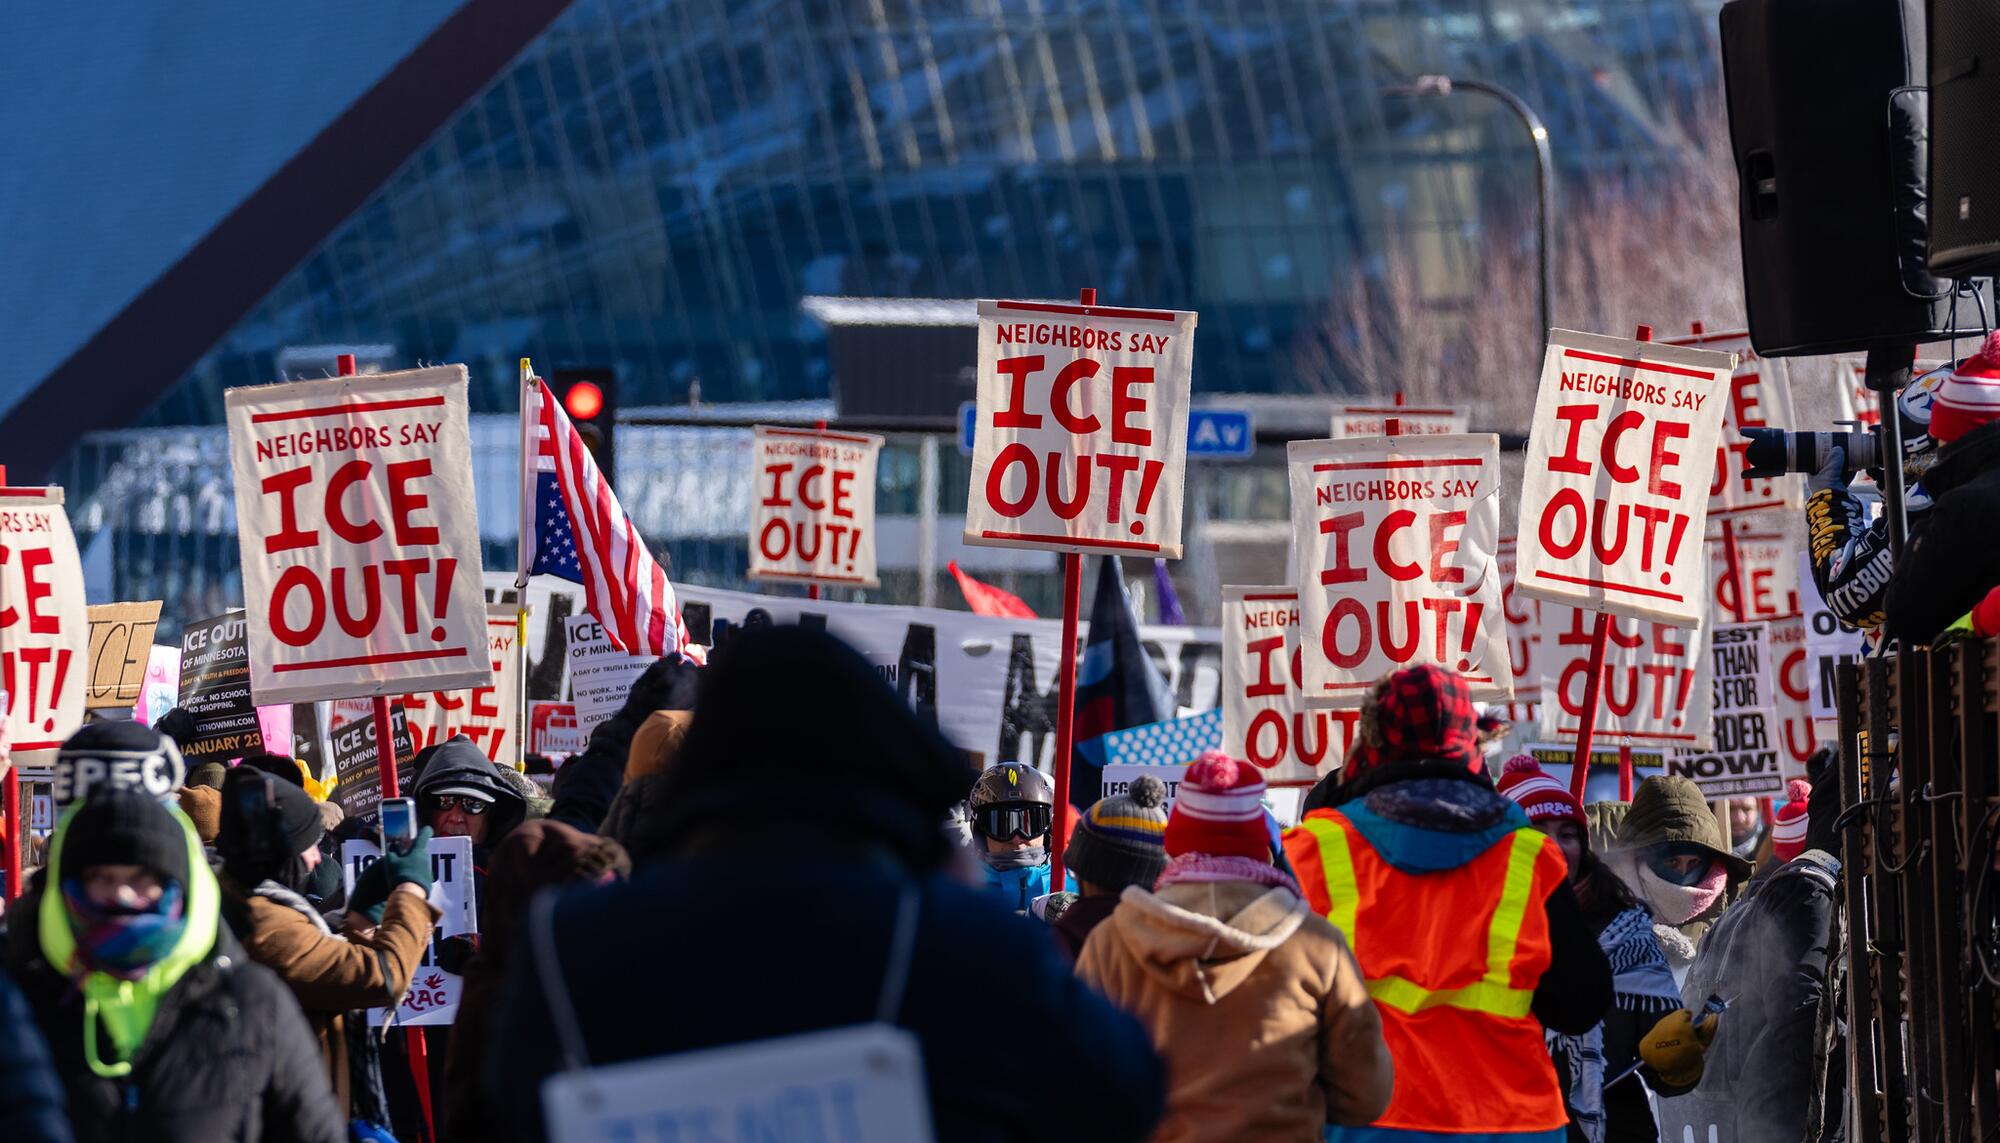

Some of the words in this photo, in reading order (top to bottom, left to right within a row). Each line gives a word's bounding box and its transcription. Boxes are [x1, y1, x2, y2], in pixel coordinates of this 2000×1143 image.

[997, 323, 1122, 351] NEIGHBORS
[1129, 332, 1169, 354] SAY
[993, 355, 1155, 446] ICE
[1559, 372, 1666, 405] NEIGHBORS
[1671, 389, 1706, 411] SAY
[1344, 421, 1422, 435] NEIGORS
[257, 425, 392, 462] NEIGHBORS
[400, 422, 442, 444] SAY
[1547, 404, 1690, 500] ICE
[763, 464, 855, 519] ICE
[985, 443, 1164, 535] OUT!
[1316, 480, 1435, 506] NEIGHBORS
[1442, 479, 1479, 498] SAY
[262, 458, 440, 554] ICE
[28, 513, 52, 533] SAY
[1538, 487, 1690, 585] OUT!
[760, 518, 862, 572] OUT!
[1320, 509, 1467, 585] ICE
[269, 558, 457, 647] OUT!
[1245, 608, 1300, 630] NEIGH
[183, 628, 208, 653] ICE
[211, 619, 248, 644] OUT
[569, 622, 603, 643] ICE
[1321, 597, 1484, 672] OUT!
[1713, 627, 1764, 643] EST
[182, 657, 194, 670] OF
[194, 645, 246, 667] MINNESOTA
[573, 647, 587, 658] OF
[579, 668, 591, 676] DAY
[603, 663, 623, 673] TRUTH
[624, 662, 629, 670] &
[209, 693, 220, 701] NO
[221, 688, 251, 700] SCHOOL.
[577, 690, 588, 698] NO
[616, 684, 627, 692] NO
[1558, 658, 1695, 728] OUT!
[188, 706, 199, 714] NO
[200, 700, 236, 713] SHOPPING.
[196, 717, 256, 732] UTNOWMN.COM
[244, 733, 261, 748] 23
[335, 728, 362, 756] ICE
[338, 758, 350, 771] OF
[1668, 752, 1778, 777] NOW!
[1525, 801, 1573, 817] MIRAC
[402, 990, 447, 1012] RAC
